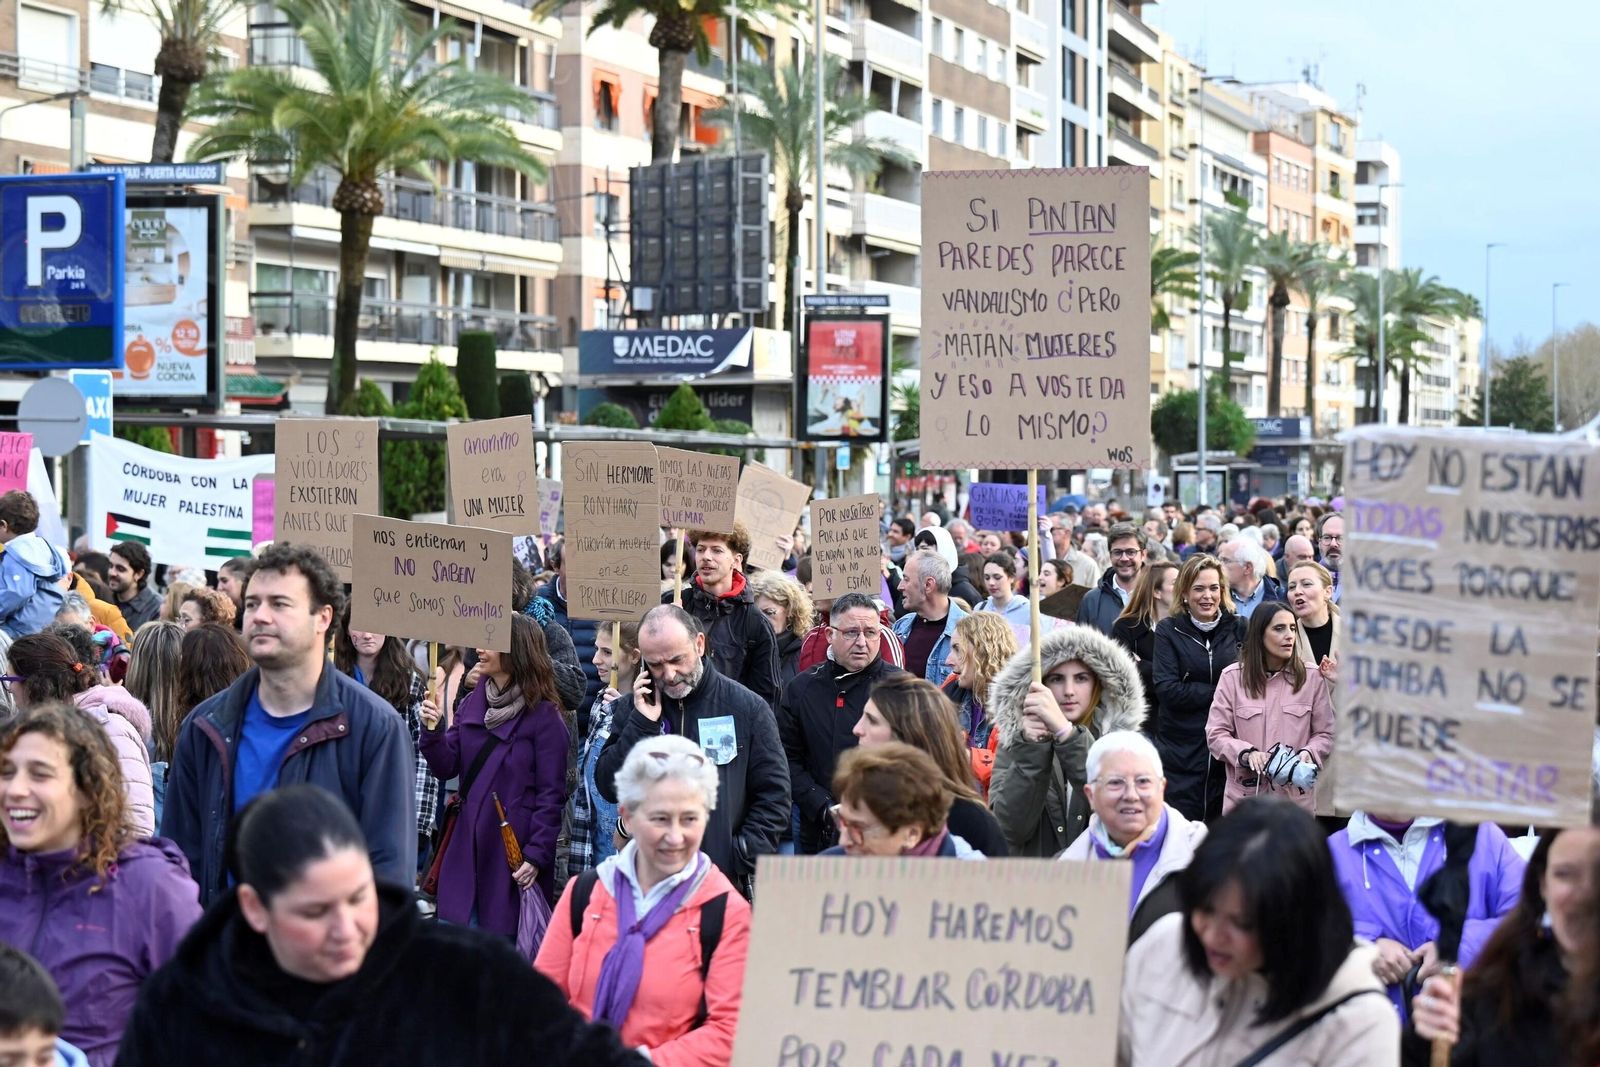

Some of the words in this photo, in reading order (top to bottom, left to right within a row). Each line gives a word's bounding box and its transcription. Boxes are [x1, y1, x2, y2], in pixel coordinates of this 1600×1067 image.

[145, 166, 175, 179] PUERTA
[175, 165, 217, 179] GALLEGOS
[966, 198, 999, 232] SI
[1028, 197, 1115, 232] PINTAN
[27, 195, 82, 286] P
[938, 241, 1034, 276] PAREDES
[1052, 243, 1126, 277] PARECE
[47, 264, 85, 280] Parkia
[942, 288, 1048, 317] VANDALISMO
[630, 334, 714, 357] MEDAC
[944, 333, 1013, 358] MATAN
[1025, 331, 1117, 358] MUJERES
[157, 362, 191, 371] NUEVA
[157, 371, 196, 381] COCINA
[930, 372, 947, 400] Y
[958, 374, 992, 399] ESO
[1010, 373, 1026, 397] A
[1100, 377, 1125, 400] DA
[86, 396, 112, 419] AXI
[709, 391, 746, 407] líder
[965, 410, 990, 437] LO
[1018, 410, 1108, 443] MISMO?
[307, 429, 340, 457] LOS
[463, 431, 520, 455] anonimo
[0, 460, 26, 479] MO
[122, 462, 181, 484] CORDOBA
[191, 475, 217, 489] CON
[232, 477, 249, 489] LA
[290, 458, 369, 483] VIOLADORES
[481, 467, 506, 483] era
[575, 457, 599, 483] SIN
[659, 459, 683, 477] OMOS
[687, 458, 703, 478] LAS
[706, 463, 732, 480] NIETAS
[1350, 441, 1418, 481] HOY
[1428, 448, 1465, 488] NO
[1480, 452, 1585, 499] ESTAN
[290, 485, 357, 505] EXISTIERON
[664, 476, 685, 493] TODAS
[686, 481, 697, 493] LAS
[702, 483, 732, 498] BRUJAS
[123, 488, 167, 508] MUJER
[179, 499, 244, 519] PALESTINA
[463, 497, 483, 517] UNA
[488, 494, 525, 514] MUJER
[613, 496, 639, 519] HARRY
[660, 494, 672, 506] UE
[680, 496, 692, 508] NO
[283, 511, 321, 532] ANTES
[325, 512, 348, 533] QUE
[663, 507, 706, 528] QUEMAR
[819, 507, 837, 526] POR
[840, 502, 874, 520] NOSOTRAS
[1350, 501, 1446, 538] TODAS
[1465, 508, 1600, 552] NUESTRAS
[373, 529, 396, 546] nos
[405, 532, 466, 553] entierran
[479, 542, 488, 562] y
[818, 530, 834, 544] POR
[835, 527, 849, 543] LAS
[852, 528, 868, 541] QUE
[815, 543, 845, 562] VENDRÁN
[847, 547, 853, 560] Y
[853, 546, 865, 558] POR
[866, 546, 878, 556] LAS
[394, 556, 416, 576] NO
[431, 559, 476, 585] SABEN
[819, 562, 833, 575] QUE
[837, 563, 847, 574] YA
[849, 561, 859, 571] NO
[847, 569, 871, 590] ESTÁN
[1350, 557, 1434, 594] VOCES
[1453, 562, 1577, 602] PORQUE
[452, 594, 504, 621] Semillas
[579, 584, 620, 608] PRIMER
[620, 588, 647, 606] LIBRO
[1350, 610, 1455, 654] DESDE
[1489, 621, 1529, 656] LA
[1350, 655, 1447, 697] TUMBA
[1477, 667, 1527, 703] NO
[1549, 675, 1590, 711] SE
[1348, 705, 1461, 753] PUEDE
[1426, 759, 1560, 803] GRITAR
[820, 893, 900, 938] HOY
[929, 900, 1077, 951] HAREMOS
[789, 966, 955, 1011] TEMBLAR
[779, 1034, 846, 1067] POR
